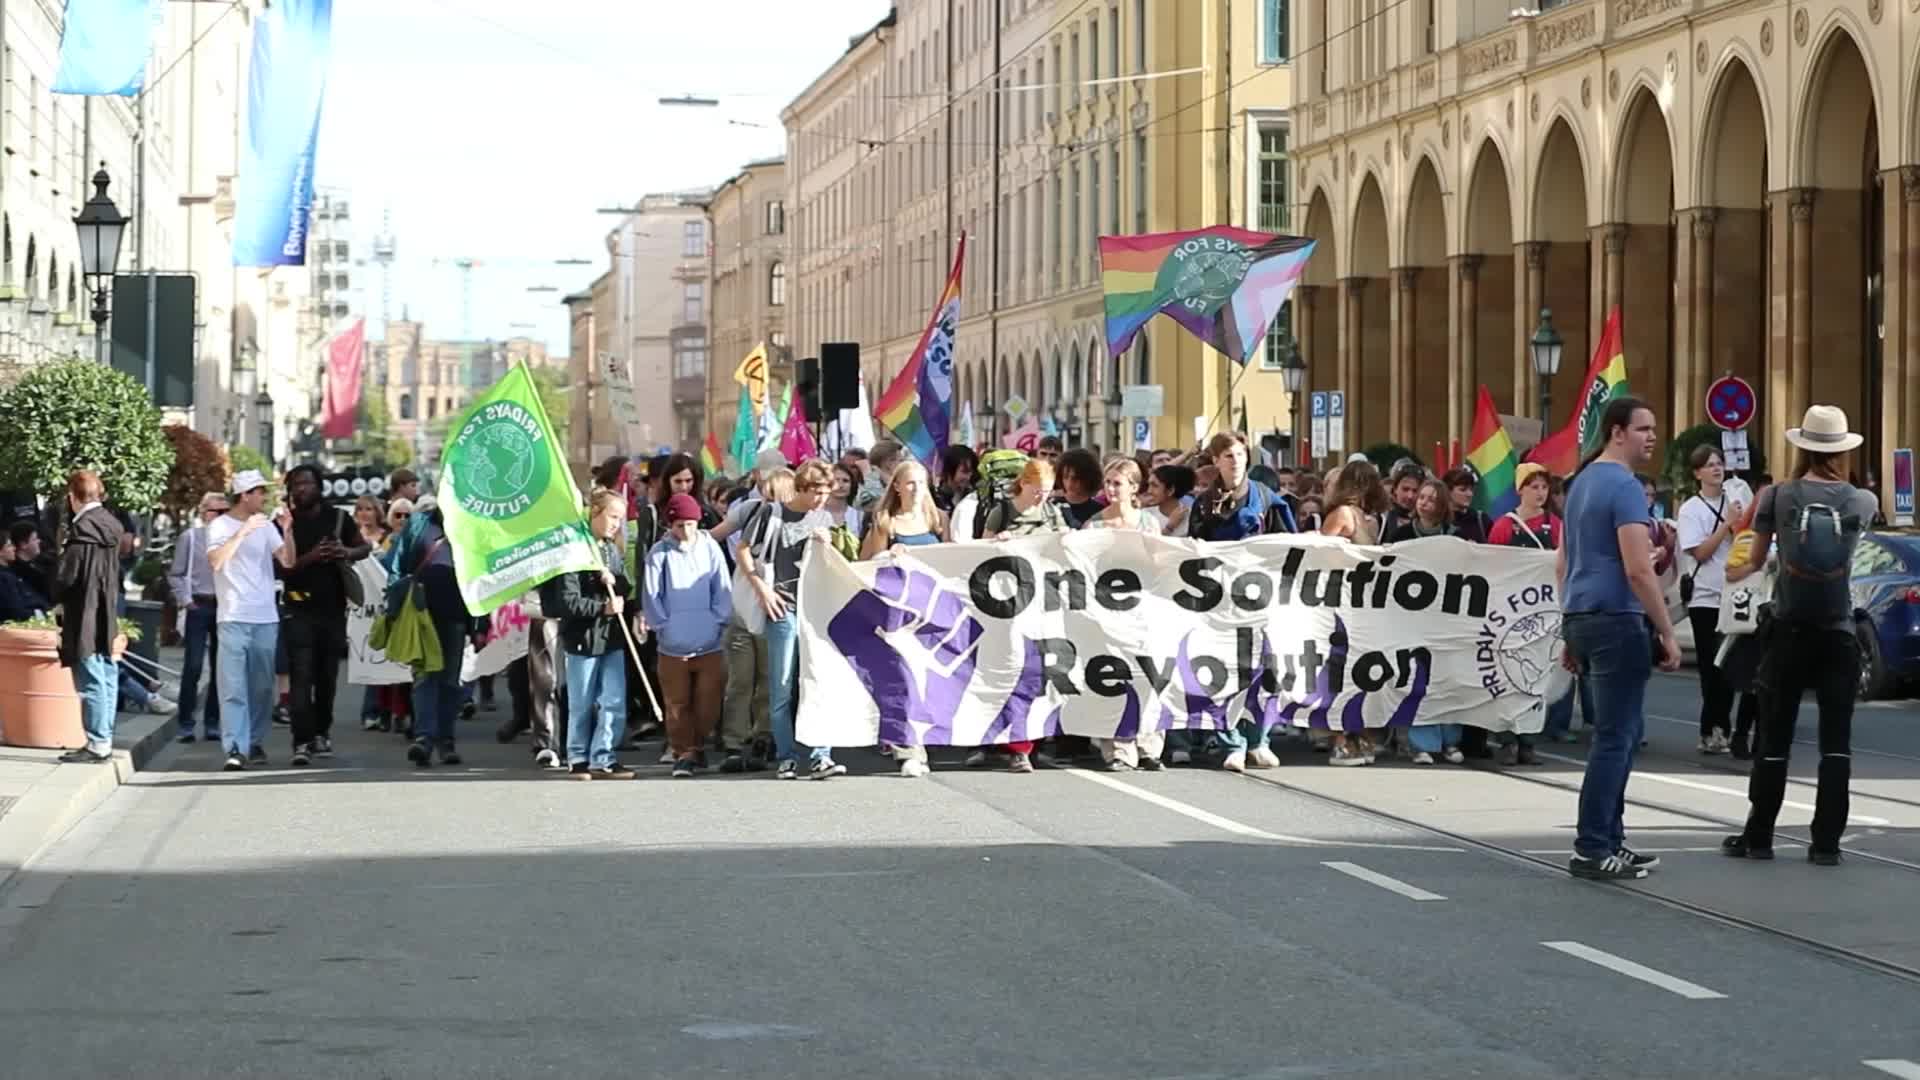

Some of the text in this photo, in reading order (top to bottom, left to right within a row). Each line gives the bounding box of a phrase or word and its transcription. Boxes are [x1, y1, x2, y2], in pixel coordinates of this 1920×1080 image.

[968, 548, 1490, 619] One Solution
[1034, 627, 1432, 697] Revolution
[1476, 584, 1554, 699] FRIDAYS FOR
